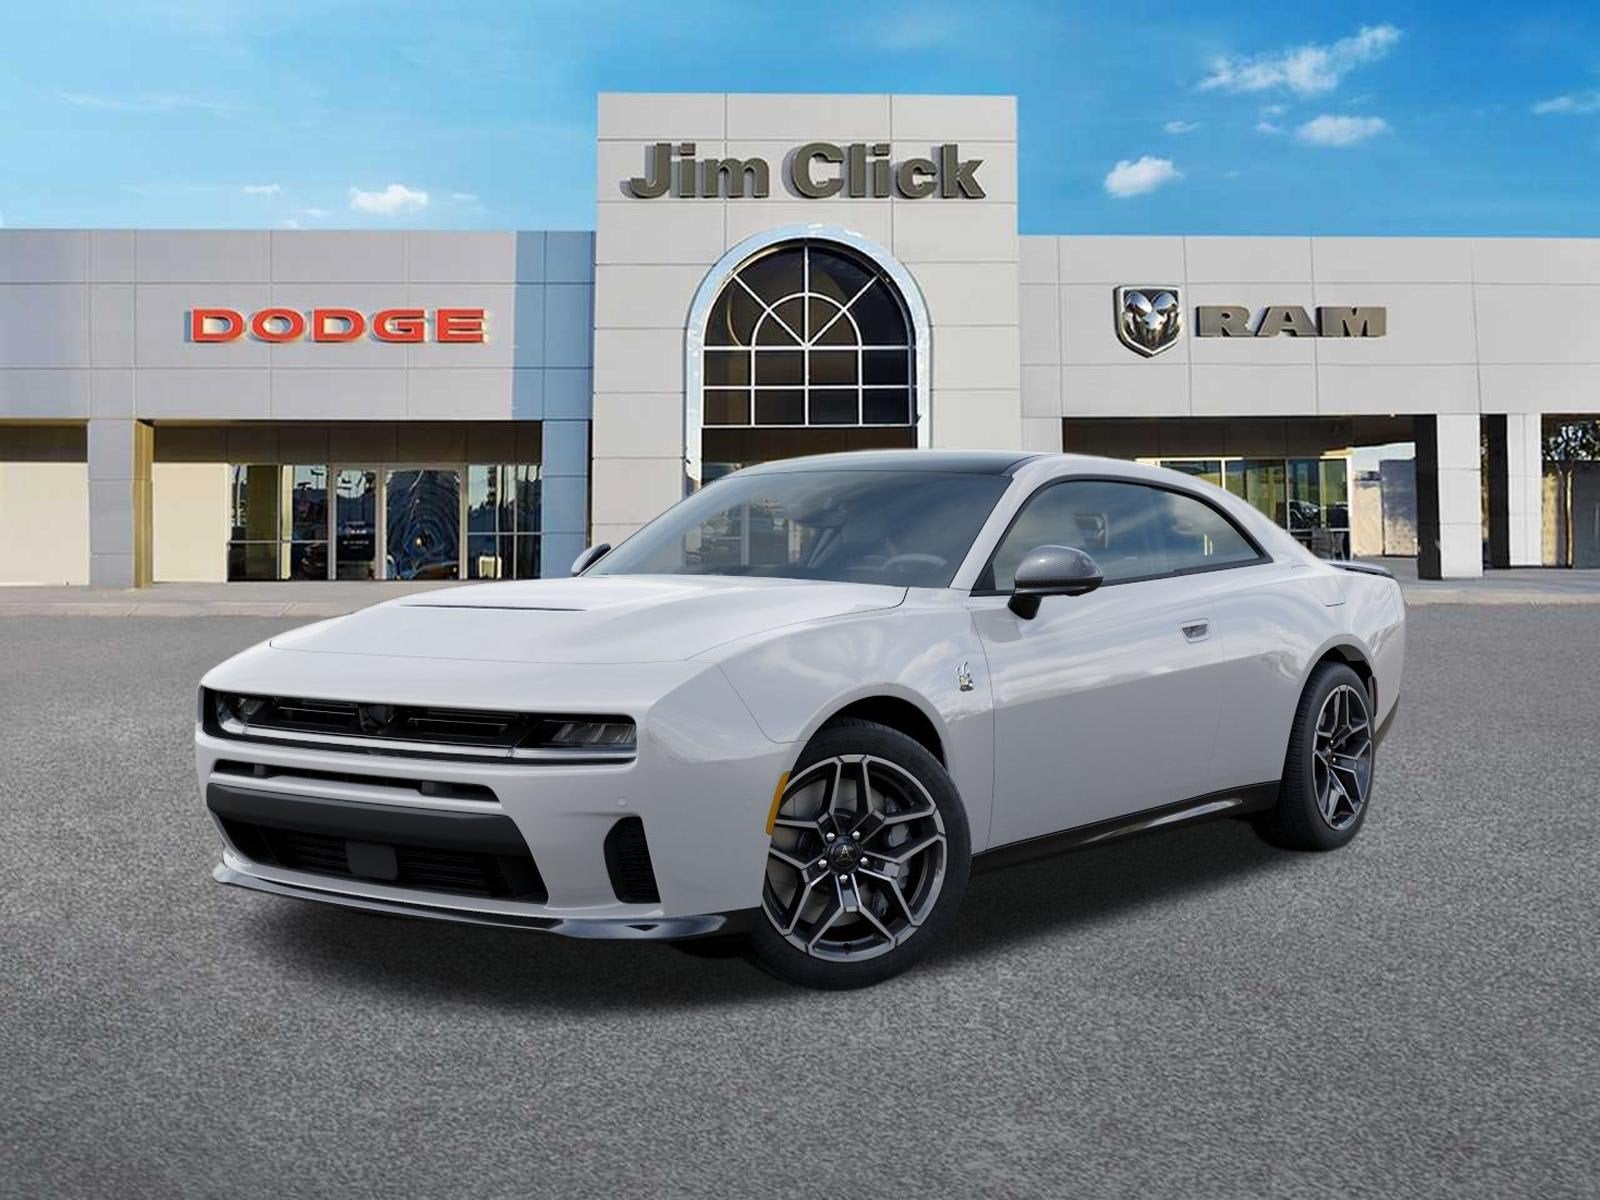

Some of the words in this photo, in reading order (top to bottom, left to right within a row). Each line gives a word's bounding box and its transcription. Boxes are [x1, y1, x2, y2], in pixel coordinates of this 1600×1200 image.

[622, 142, 769, 198] Jim
[785, 142, 986, 199] Click
[188, 307, 486, 343] DODGE
[1195, 305, 1387, 337] RAM
